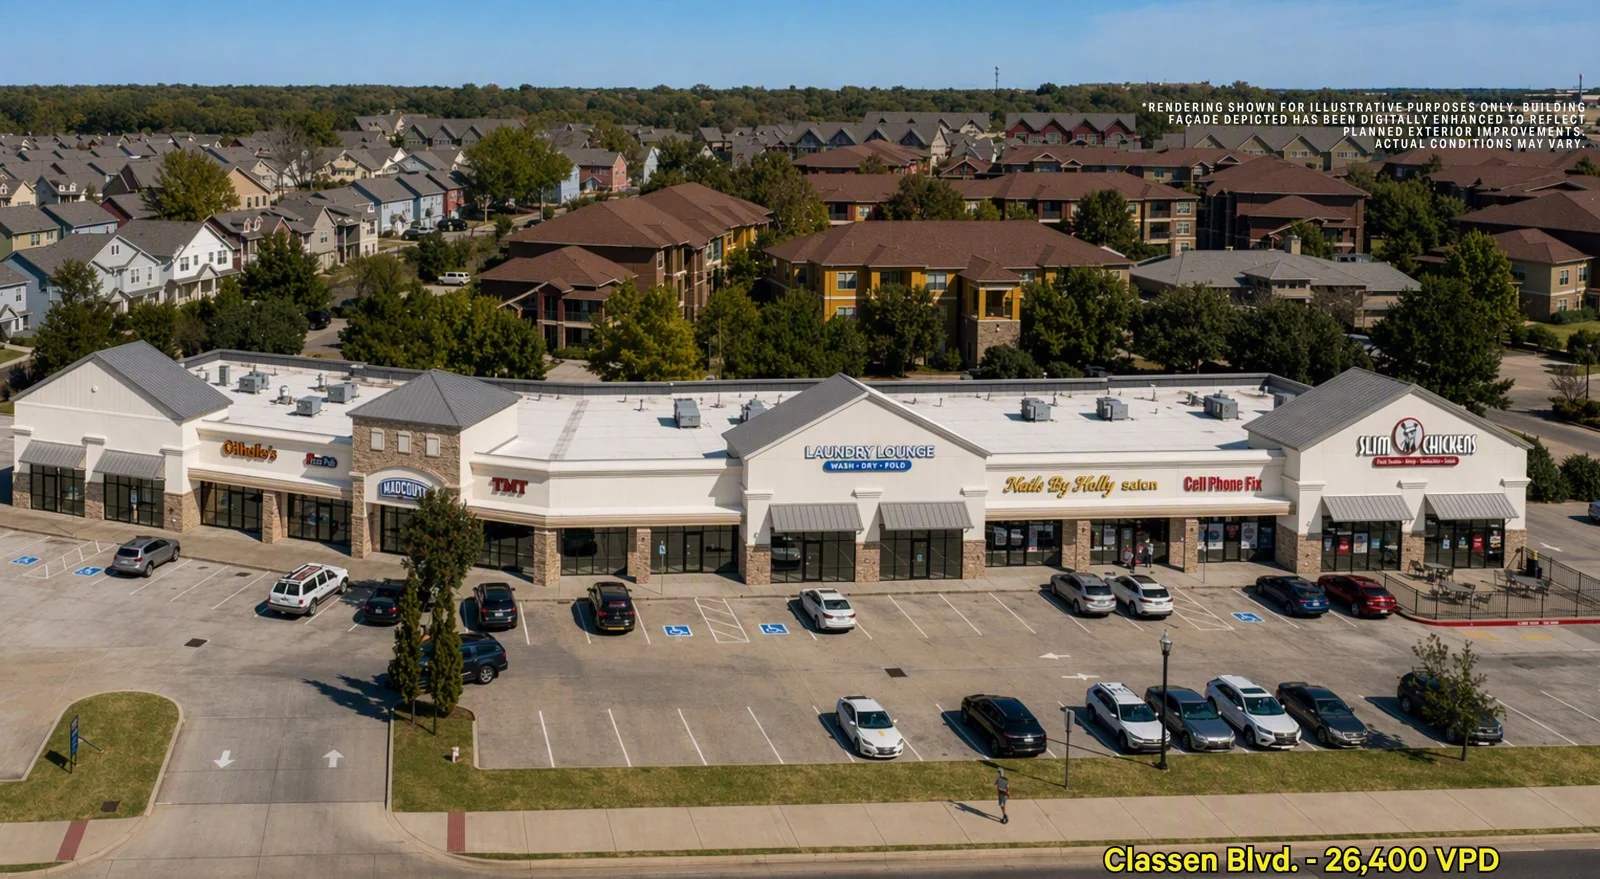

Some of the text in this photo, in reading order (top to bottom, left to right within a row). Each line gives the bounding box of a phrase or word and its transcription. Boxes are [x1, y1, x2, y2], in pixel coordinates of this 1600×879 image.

[805, 445, 935, 459] LAUNDRY LOUNGE
[1358, 434, 1477, 456] SLIM CHICKENS
[830, 461, 906, 470] WASH DRY FOLD
[491, 476, 529, 495] TMT
[1003, 475, 1158, 498] Nails By Holly salon
[1183, 476, 1262, 492] Cell Phone Fix
